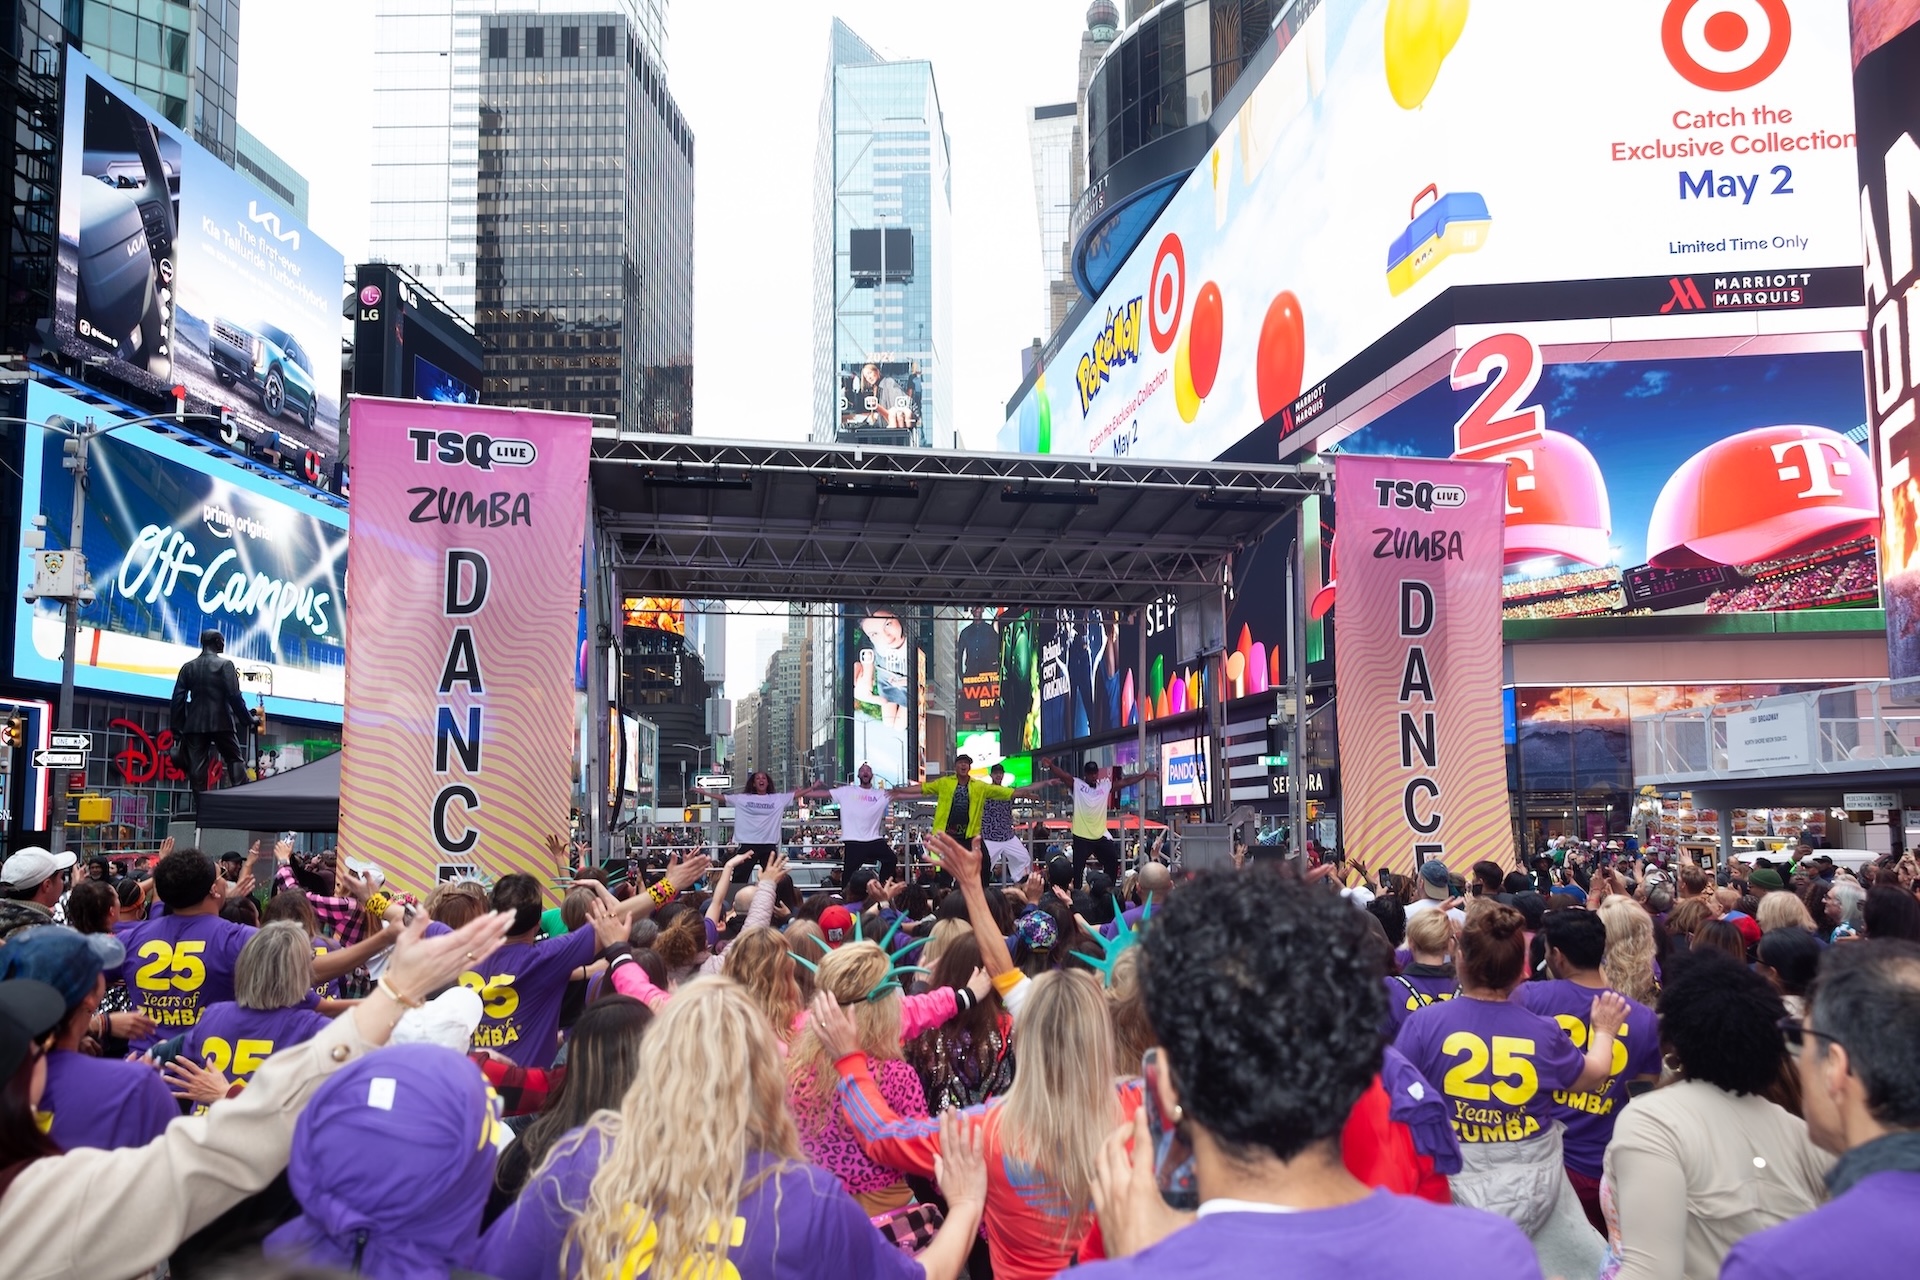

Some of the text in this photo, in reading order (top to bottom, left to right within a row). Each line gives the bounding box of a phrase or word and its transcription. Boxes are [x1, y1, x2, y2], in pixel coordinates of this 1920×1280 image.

[1672, 105, 1792, 130] Catch the
[1611, 130, 1857, 161] Exclusive Collection
[1679, 165, 1794, 205] May 2
[237, 220, 302, 278] The first-ever
[1669, 235, 1809, 254] Limited Time Only
[202, 215, 221, 241] Kia
[222, 229, 266, 271] Telluride
[267, 260, 328, 313] Turbo-Hybrid
[1714, 273, 1811, 290] MARRIOTT
[1715, 289, 1801, 306] MARQUIS
[361, 309, 379, 321] LG
[1295, 383, 1327, 413] MARRIOTT
[1450, 332, 1545, 459] 2
[1089, 369, 1168, 453] Catch the Exclusive Collection
[1295, 399, 1324, 425] MARQUIS
[409, 428, 526, 471] TSQ LIVE
[1113, 420, 1138, 457] May 2
[406, 486, 532, 528] ZUMBA
[1375, 479, 1459, 512] TSQ LIVE
[203, 503, 273, 541] prime original
[1372, 527, 1465, 562] ZUMBA
[980, 699, 995, 707] BUY
[1272, 758, 1281, 766] 46
[1273, 773, 1323, 794] SEPRA
[135, 939, 206, 992] 25
[142, 991, 200, 1009] Years of
[316, 981, 329, 996] of
[1442, 1031, 1539, 1105] 25
[1455, 1100, 1502, 1125] Years
[1552, 1089, 1614, 1115] UMBA
